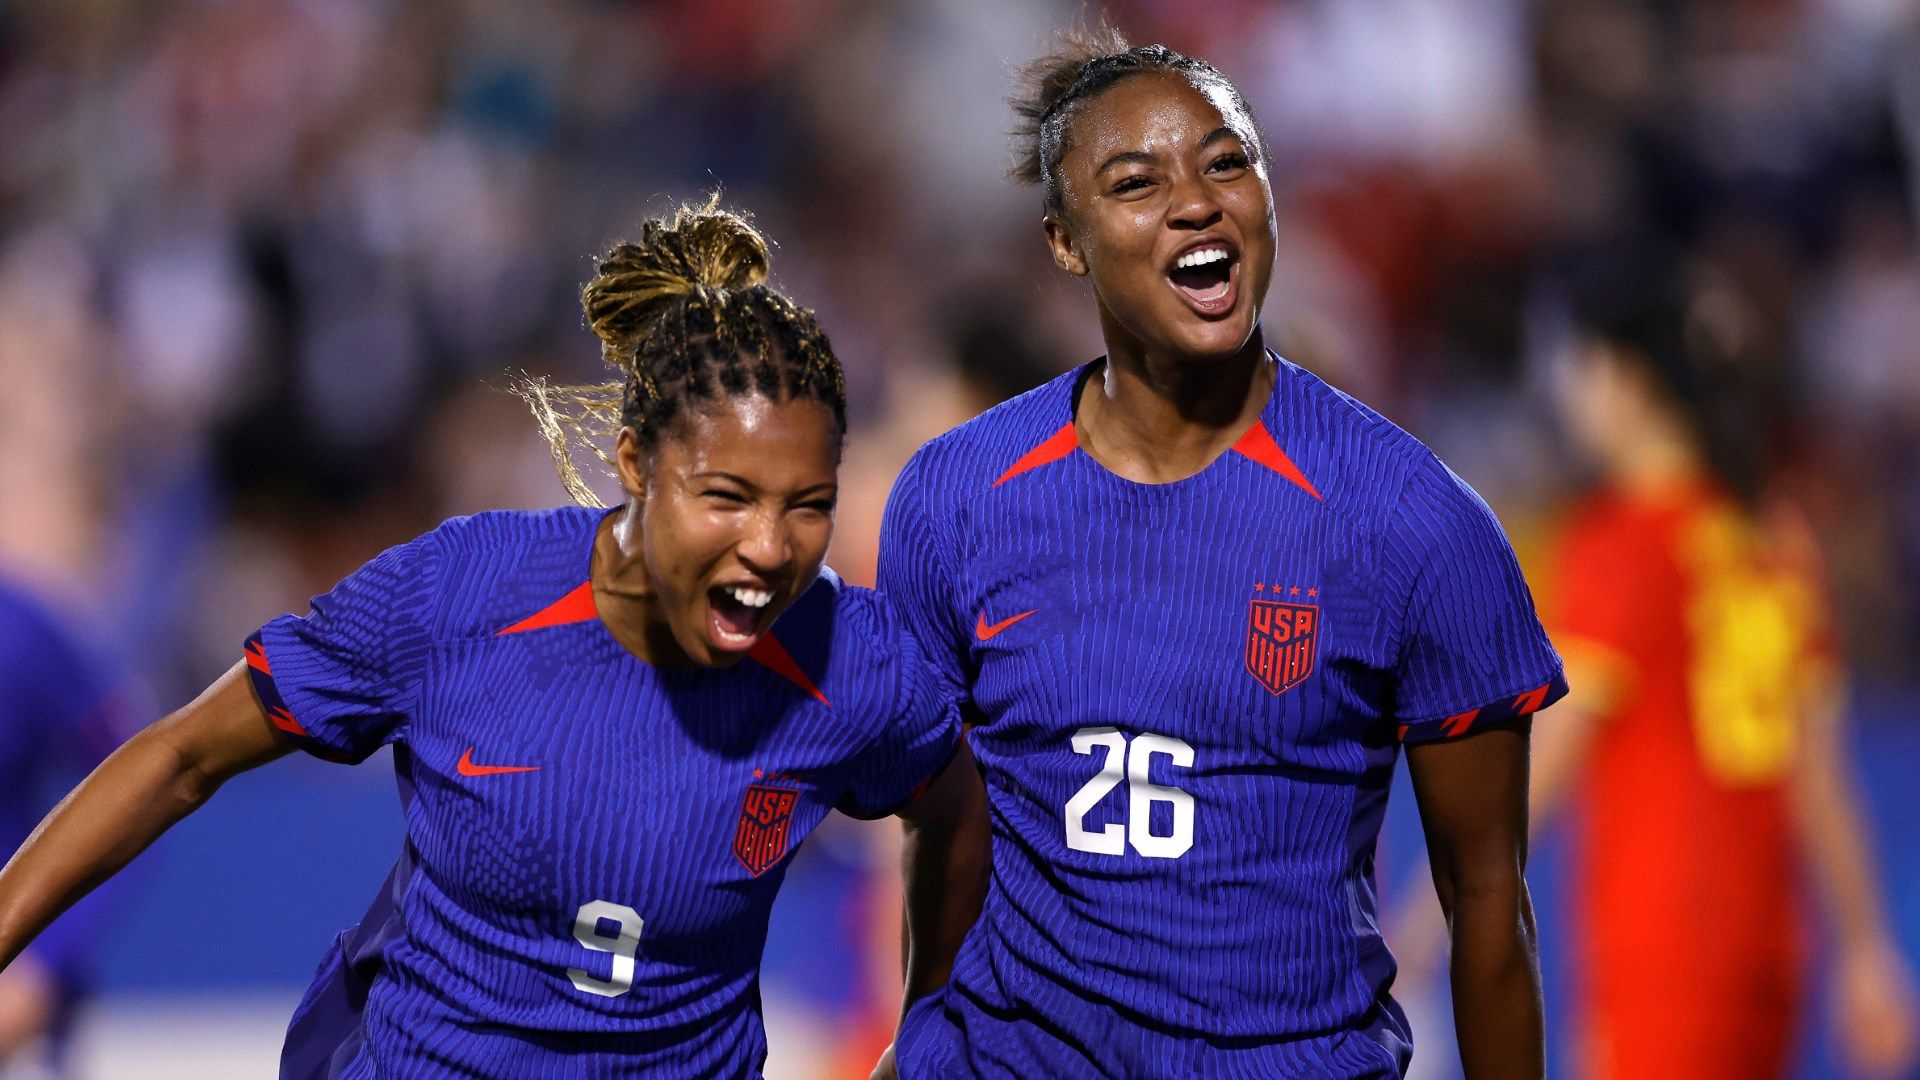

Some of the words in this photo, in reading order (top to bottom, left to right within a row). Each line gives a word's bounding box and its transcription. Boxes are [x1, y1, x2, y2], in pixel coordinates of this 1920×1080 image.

[1254, 606, 1313, 643] USA
[745, 790, 795, 825] USA
[1064, 726, 1195, 859] 26
[566, 899, 644, 998] 9
